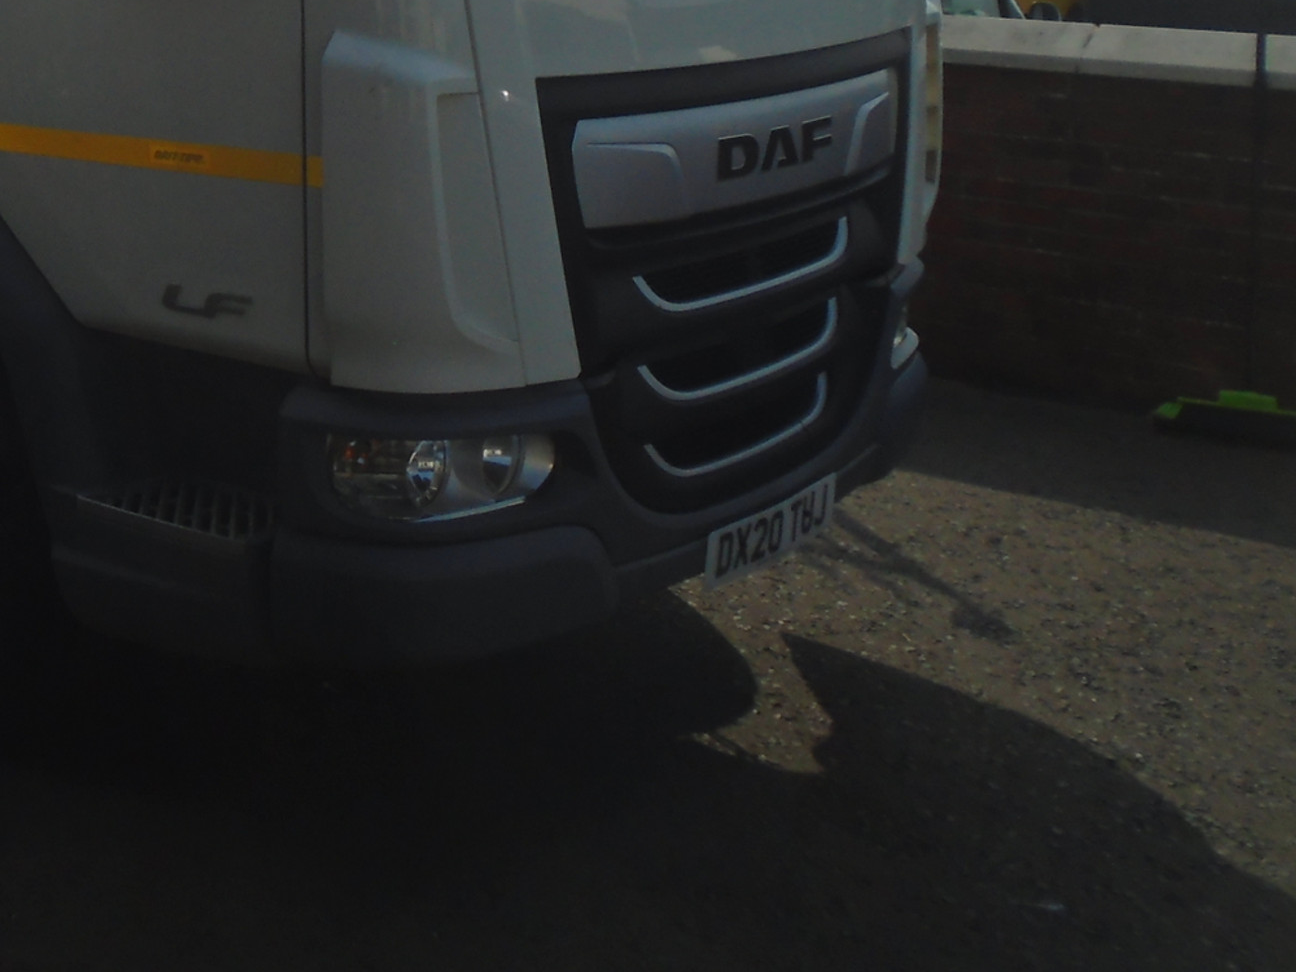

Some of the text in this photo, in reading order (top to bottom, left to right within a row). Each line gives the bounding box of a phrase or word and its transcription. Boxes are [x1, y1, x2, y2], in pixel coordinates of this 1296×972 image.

[716, 114, 832, 182] DAF
[162, 284, 253, 319] LF
[715, 509, 784, 578] DX20
